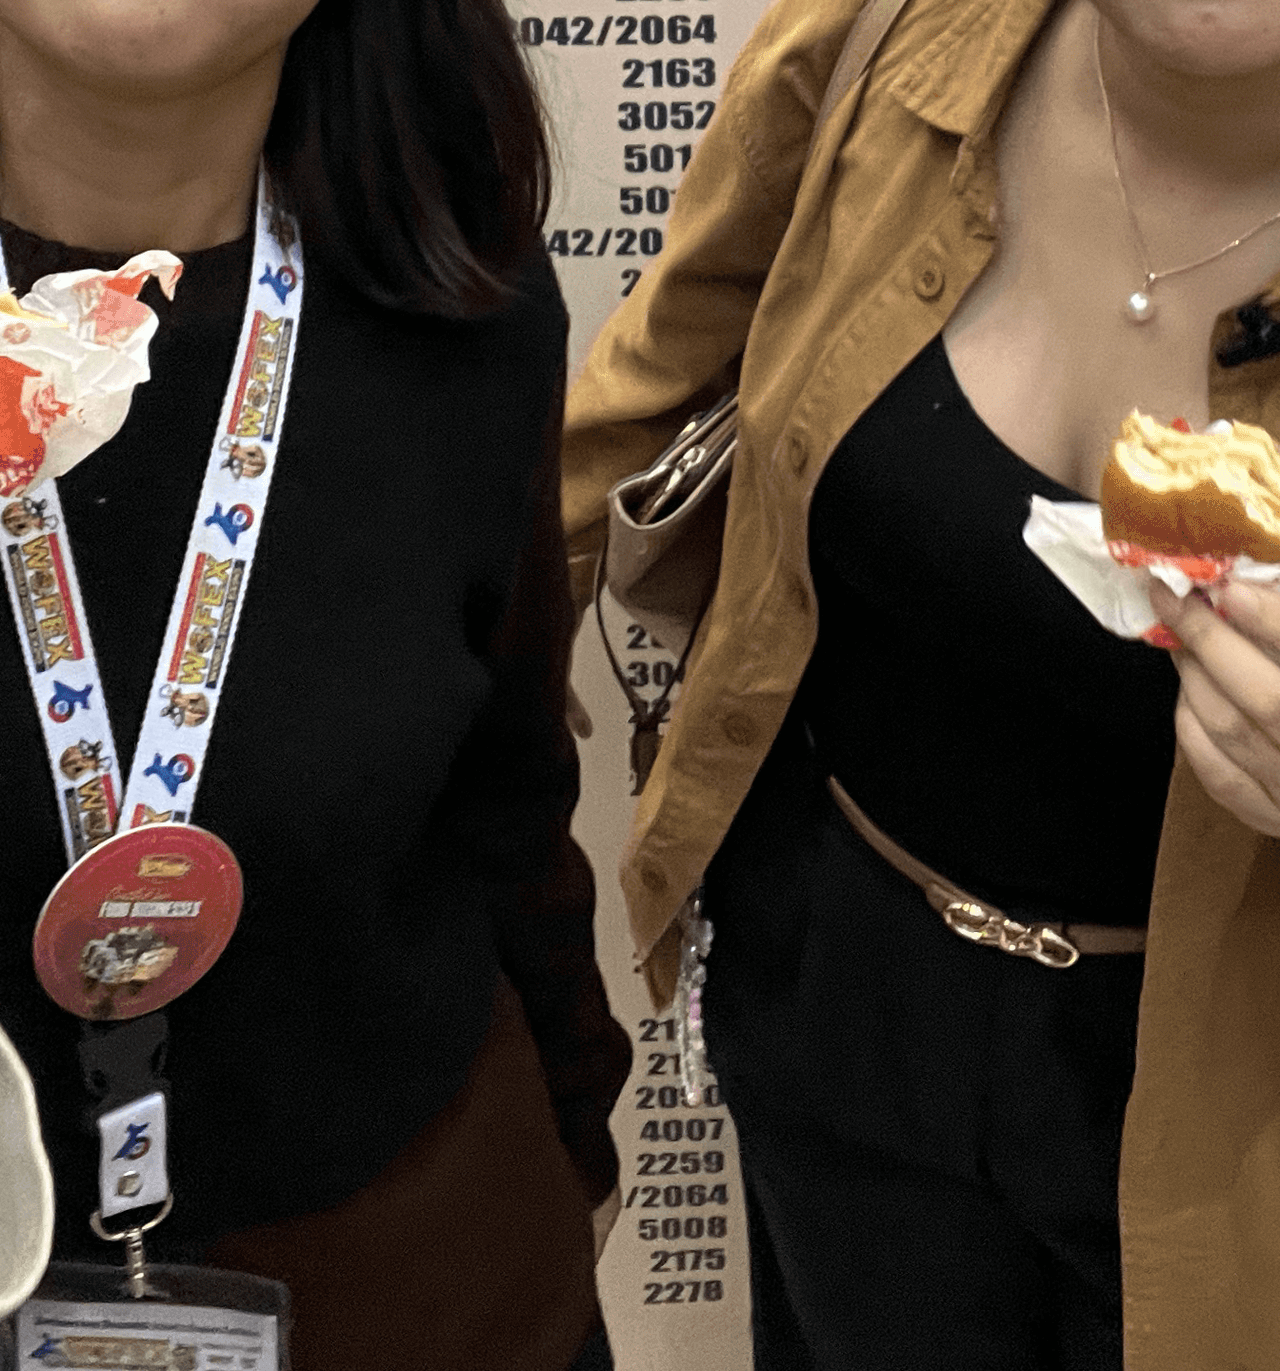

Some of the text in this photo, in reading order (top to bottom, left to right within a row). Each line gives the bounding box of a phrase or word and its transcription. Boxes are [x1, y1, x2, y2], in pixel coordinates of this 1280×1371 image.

[236, 312, 284, 438] WOFEX
[177, 555, 234, 685] WOFEX
[640, 1118, 724, 1142] 4007
